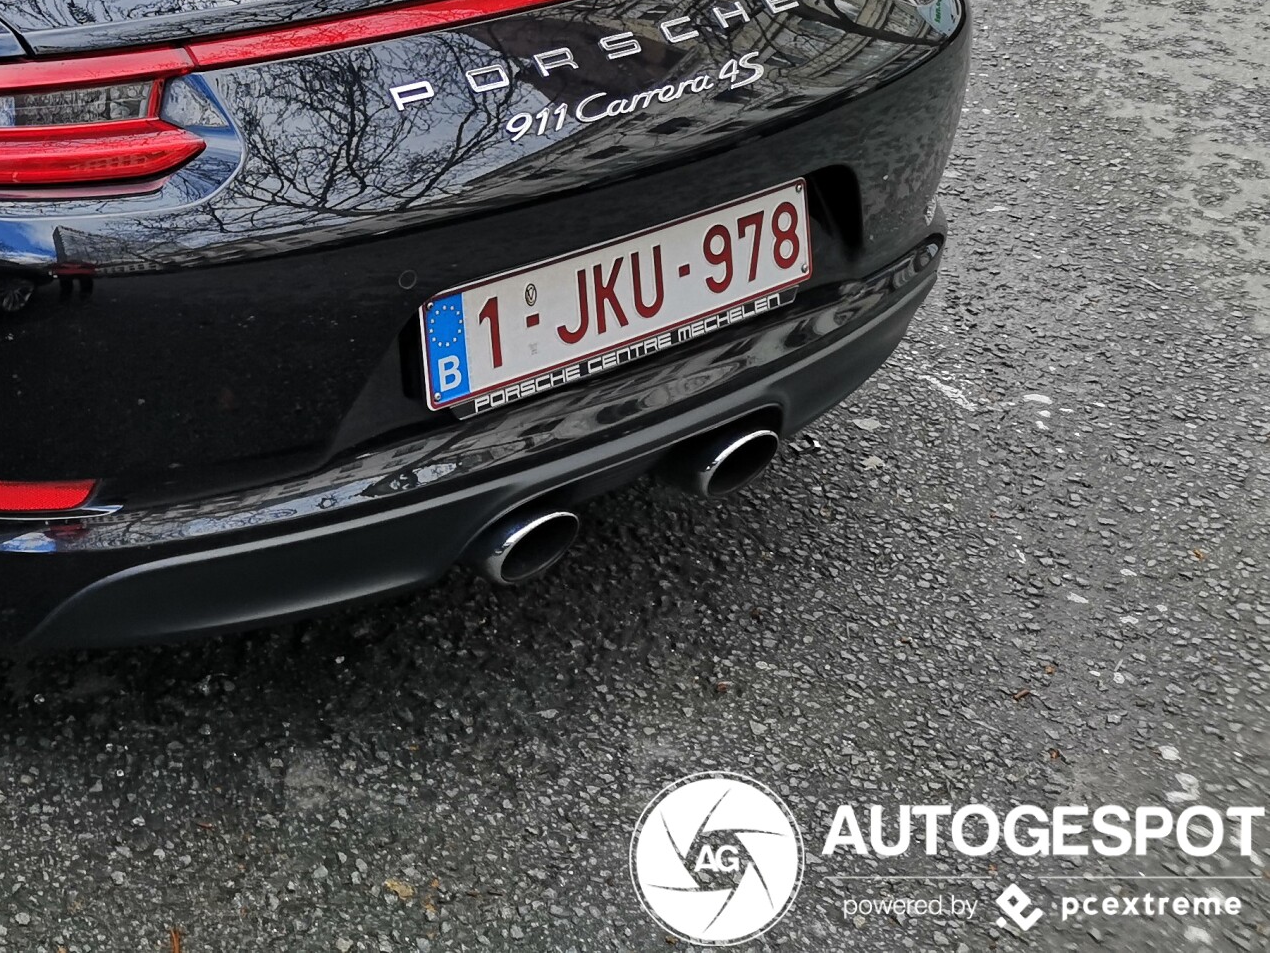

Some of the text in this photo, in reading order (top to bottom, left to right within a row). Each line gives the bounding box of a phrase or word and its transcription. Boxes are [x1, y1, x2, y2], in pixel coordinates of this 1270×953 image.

[505, 50, 764, 143] 911 Carrera 4S
[478, 201, 801, 370] 1-JKU-978
[437, 354, 463, 393] B
[474, 291, 783, 414] PORSCHE CENTRE MECHELEN
